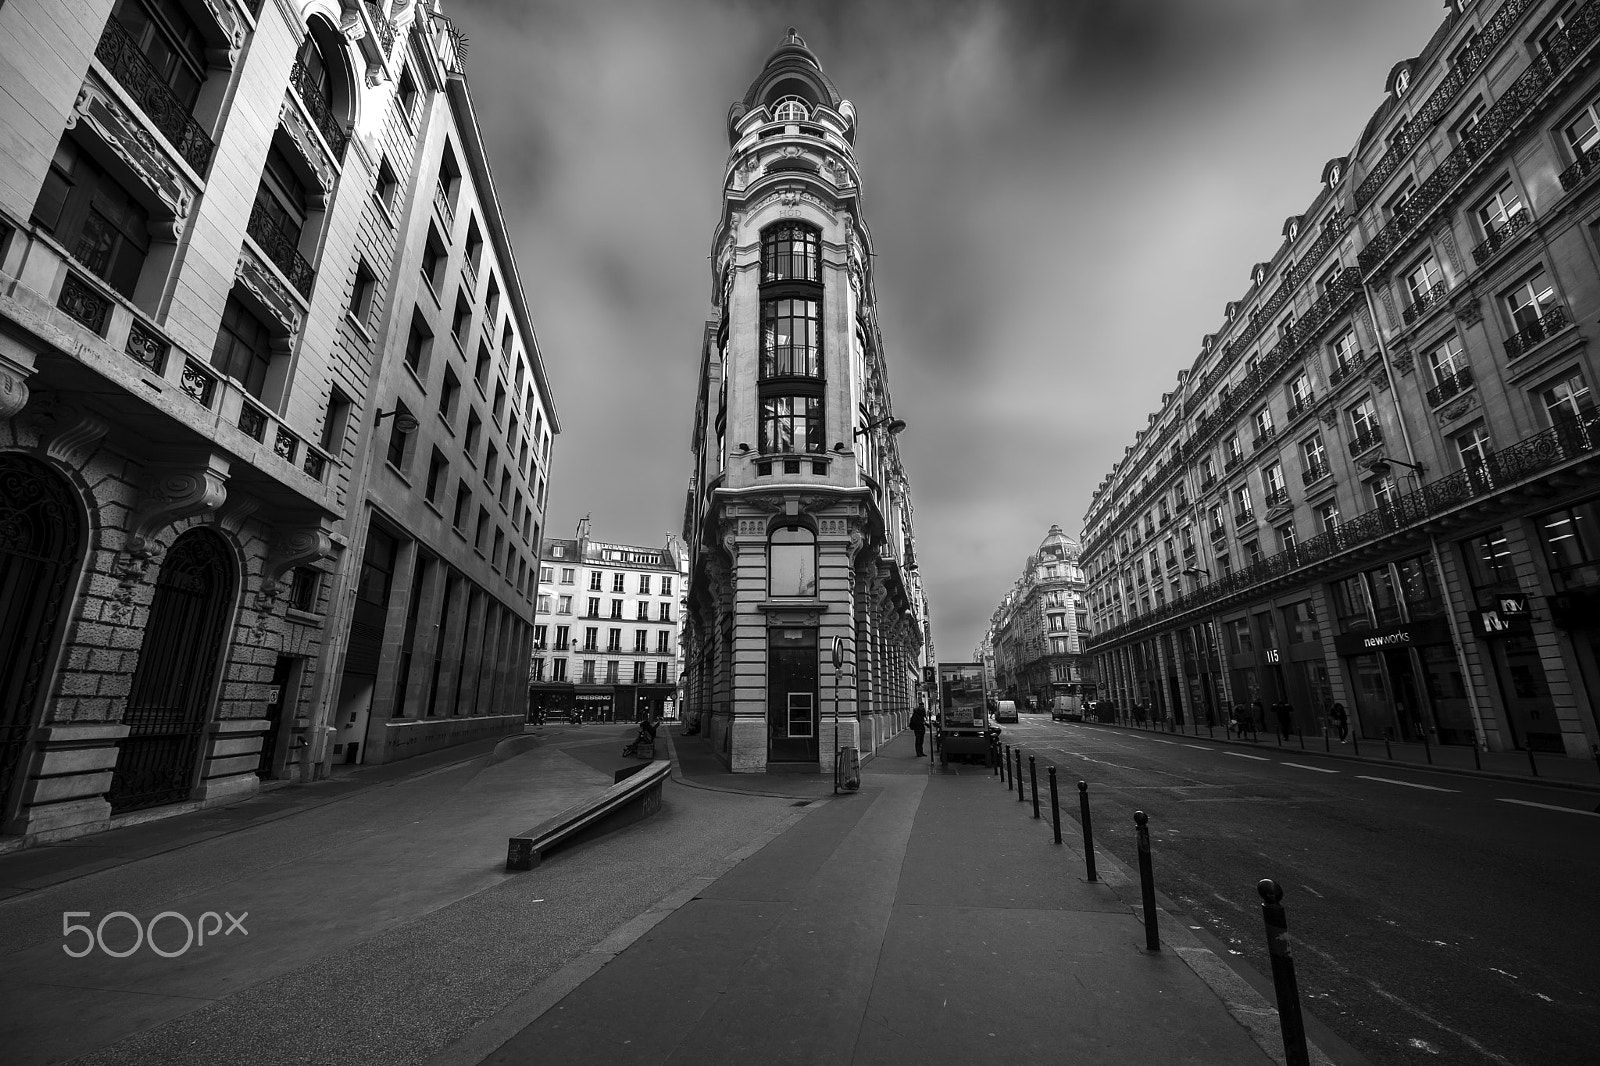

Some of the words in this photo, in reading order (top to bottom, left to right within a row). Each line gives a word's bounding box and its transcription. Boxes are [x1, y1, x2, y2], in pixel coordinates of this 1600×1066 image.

[1363, 630, 1410, 648] newworks
[1266, 649, 1280, 663] 115
[926, 669, 933, 681] P
